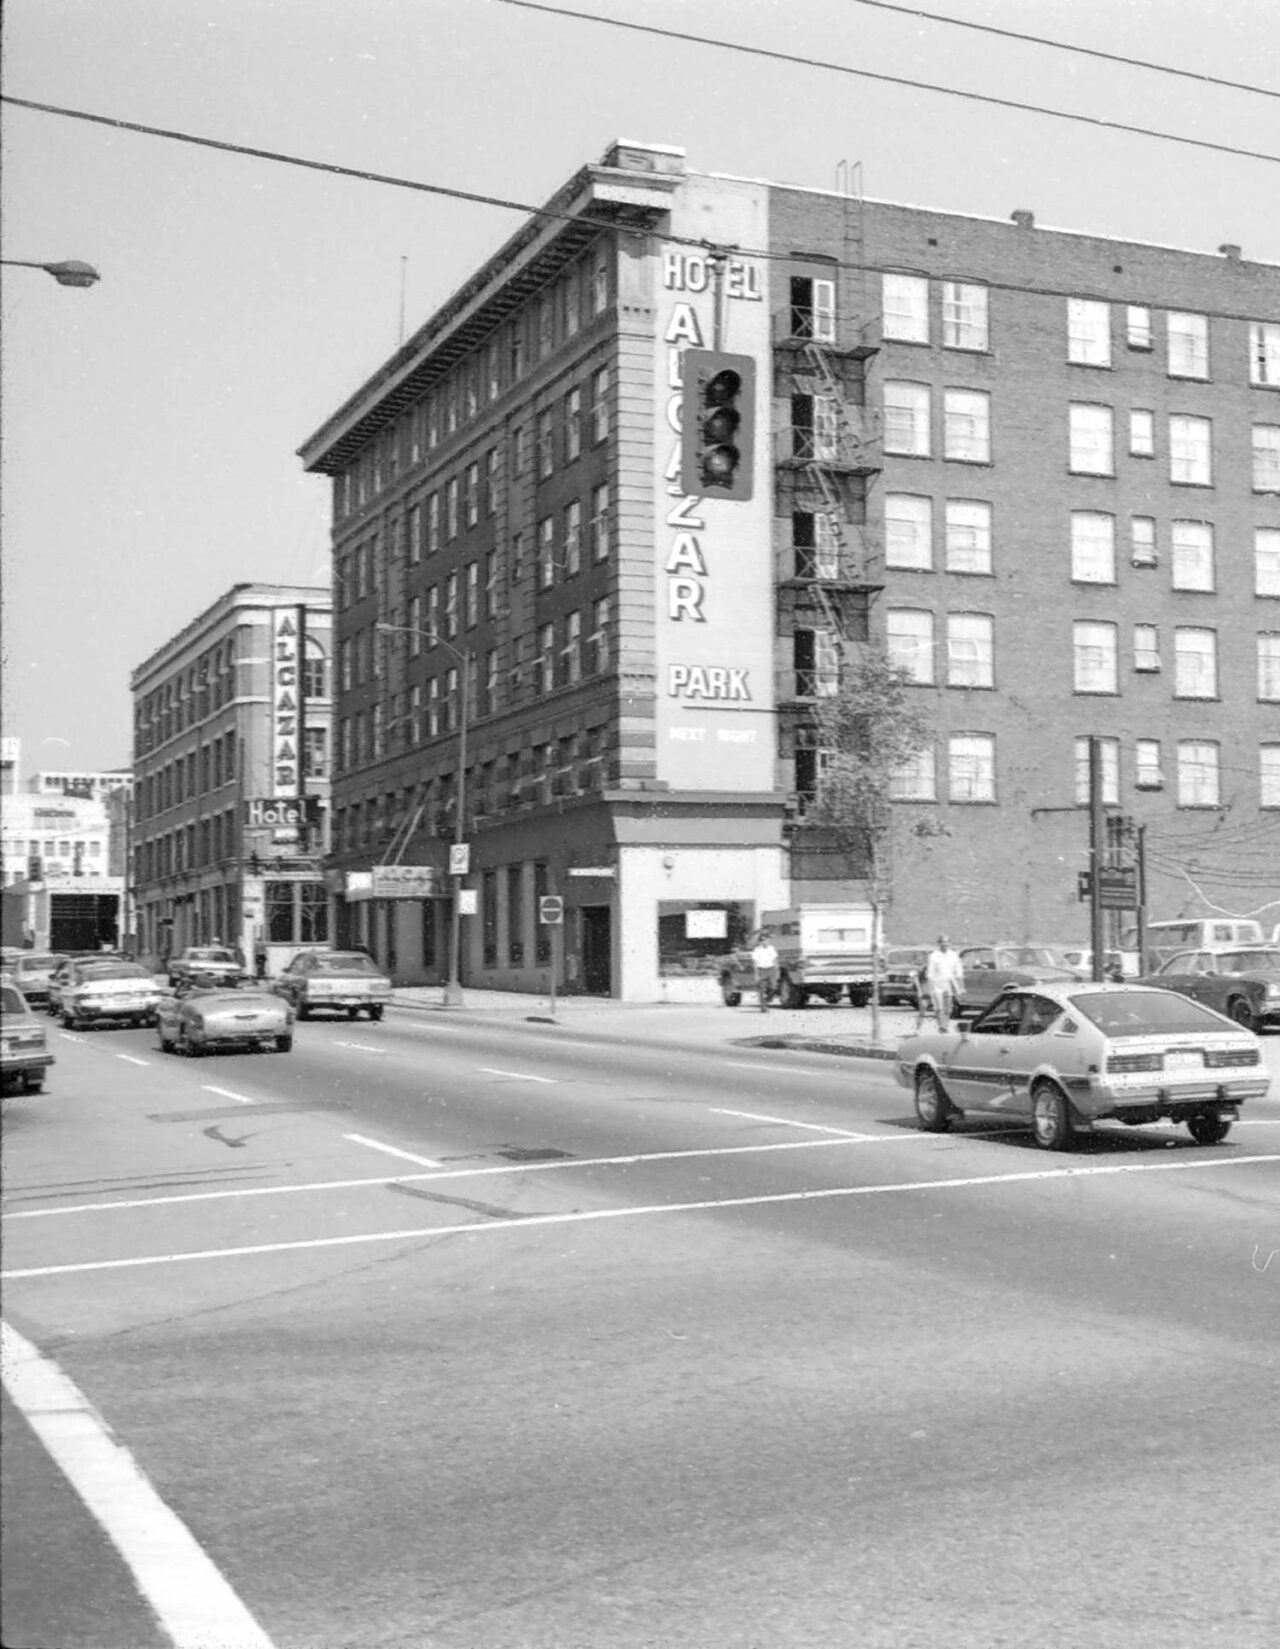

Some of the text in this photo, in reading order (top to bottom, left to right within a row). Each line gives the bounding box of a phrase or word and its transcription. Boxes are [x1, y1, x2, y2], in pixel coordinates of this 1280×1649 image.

[275, 615, 297, 786] ALCAZAR
[667, 663, 752, 702] PARK
[249, 800, 307, 825] Hotel
